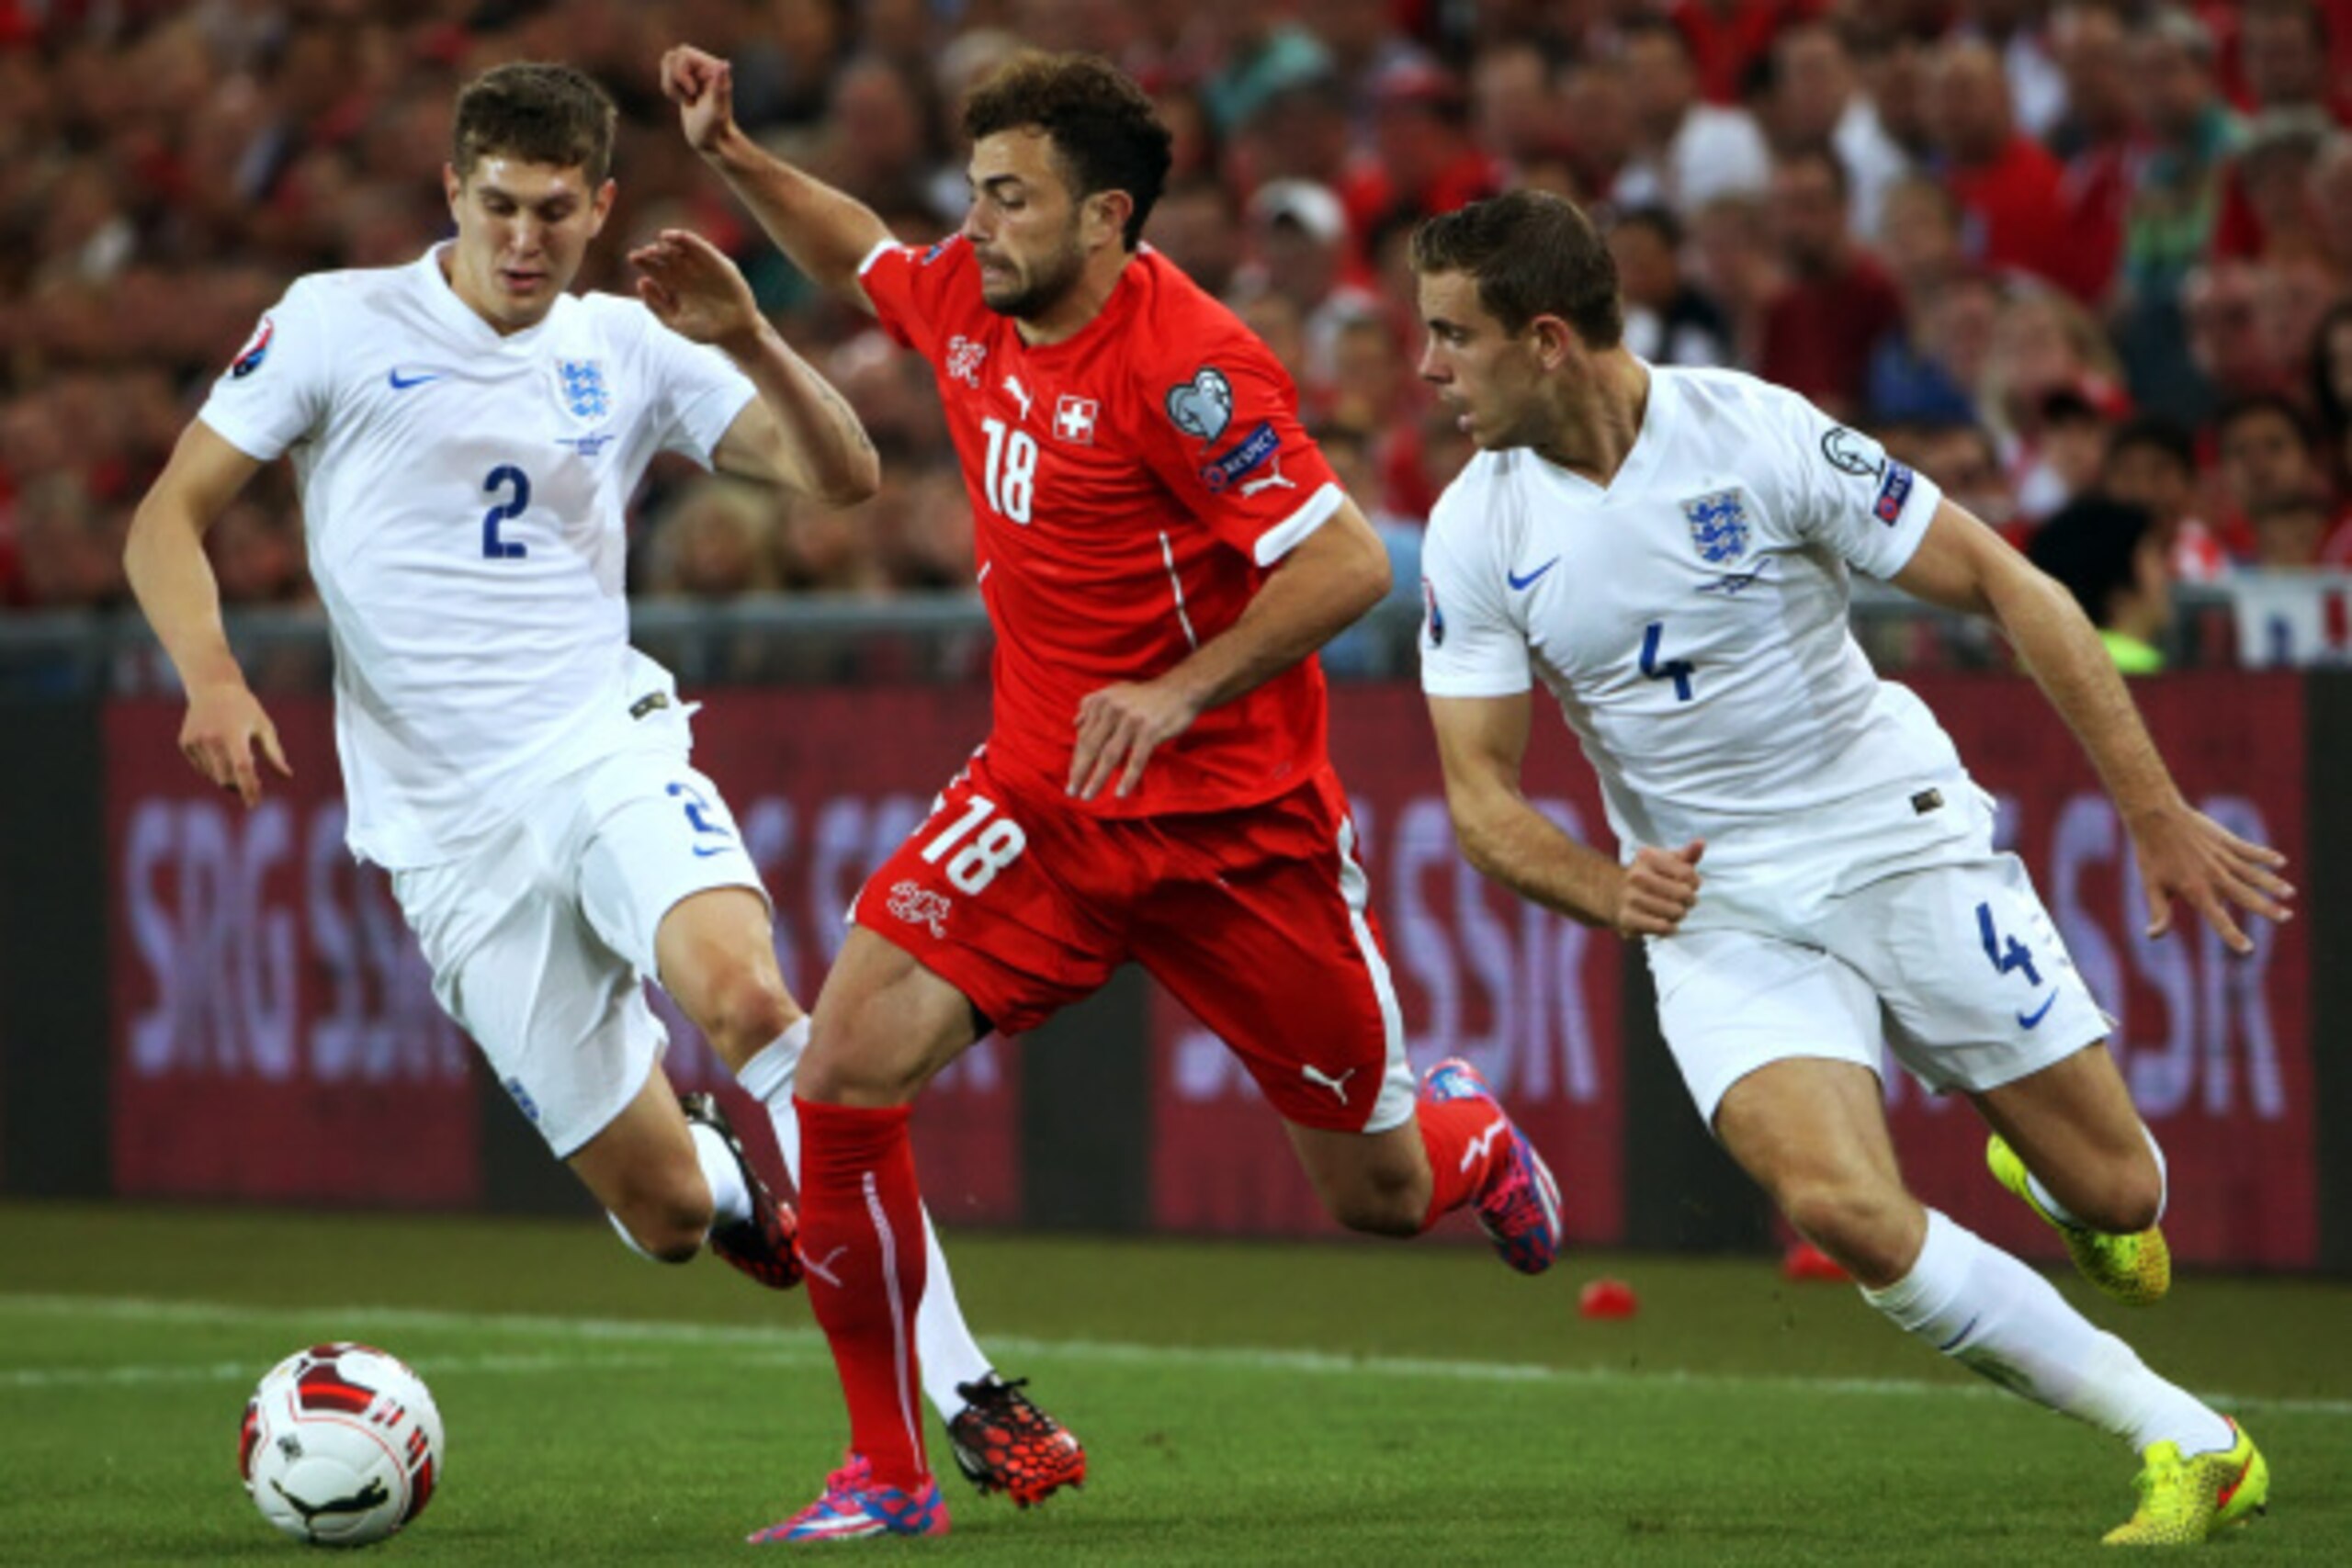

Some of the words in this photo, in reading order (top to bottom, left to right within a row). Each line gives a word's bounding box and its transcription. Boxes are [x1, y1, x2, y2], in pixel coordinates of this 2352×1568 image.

[482, 466, 530, 558] 2
[981, 417, 1038, 525] 18
[1639, 623, 1694, 701] 4
[666, 782, 731, 835] 2
[921, 795, 1026, 896] 18
[127, 795, 294, 1082] SRG
[1976, 902, 2041, 987] 4
